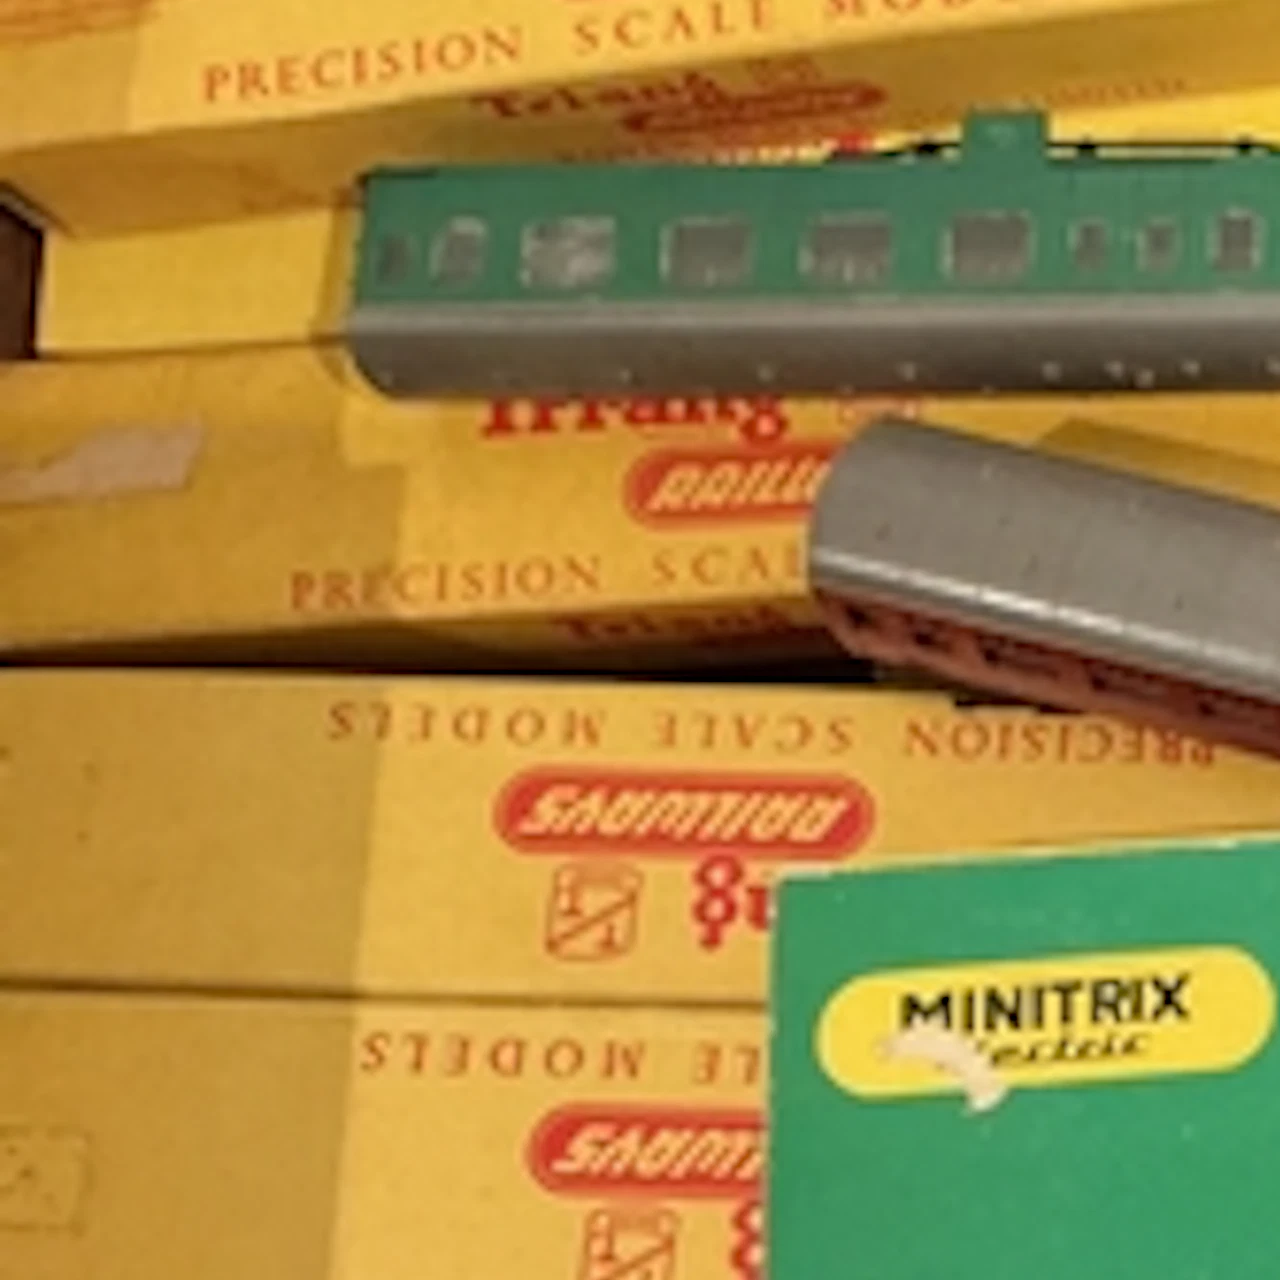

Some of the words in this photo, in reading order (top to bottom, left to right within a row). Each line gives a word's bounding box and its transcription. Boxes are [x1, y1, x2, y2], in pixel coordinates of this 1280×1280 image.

[203, 25, 523, 103] PRECISION
[291, 555, 602, 610] PRECISION
[651, 540, 801, 586] SCAL
[329, 700, 602, 746] MODELS
[655, 710, 853, 755] SCALE
[905, 717, 1215, 768] PRECISION
[518, 783, 848, 843] RAILWAYS
[901, 971, 1193, 1033] MINITRIX
[360, 1031, 645, 1082] MODELS
[970, 1029, 1151, 1069] ectric
[552, 1121, 765, 1181] LWAYS
